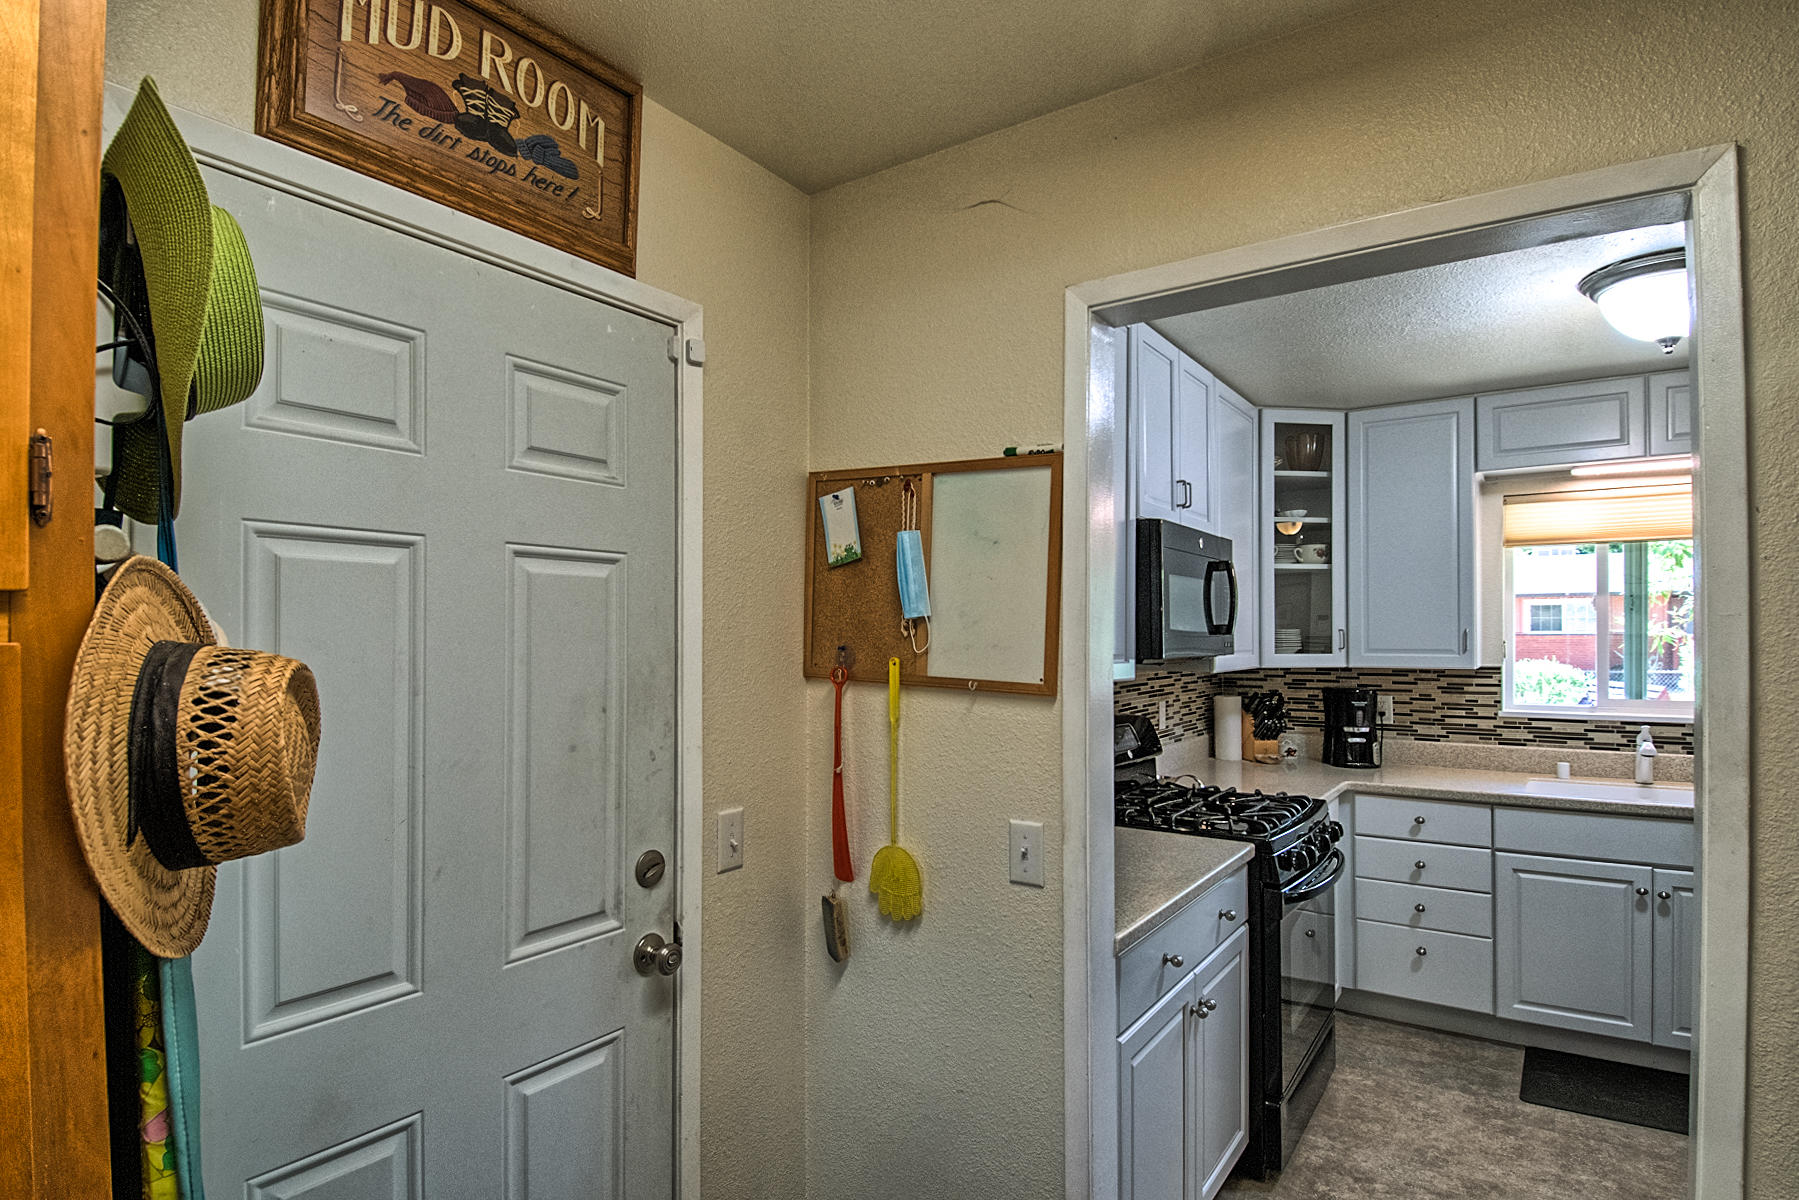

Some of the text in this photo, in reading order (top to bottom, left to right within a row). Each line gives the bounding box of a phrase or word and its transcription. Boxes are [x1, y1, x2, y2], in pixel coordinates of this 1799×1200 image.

[339, 0, 605, 168] MUD ROOM
[372, 95, 413, 131] The
[418, 123, 462, 150] dirt
[466, 147, 517, 176] stops
